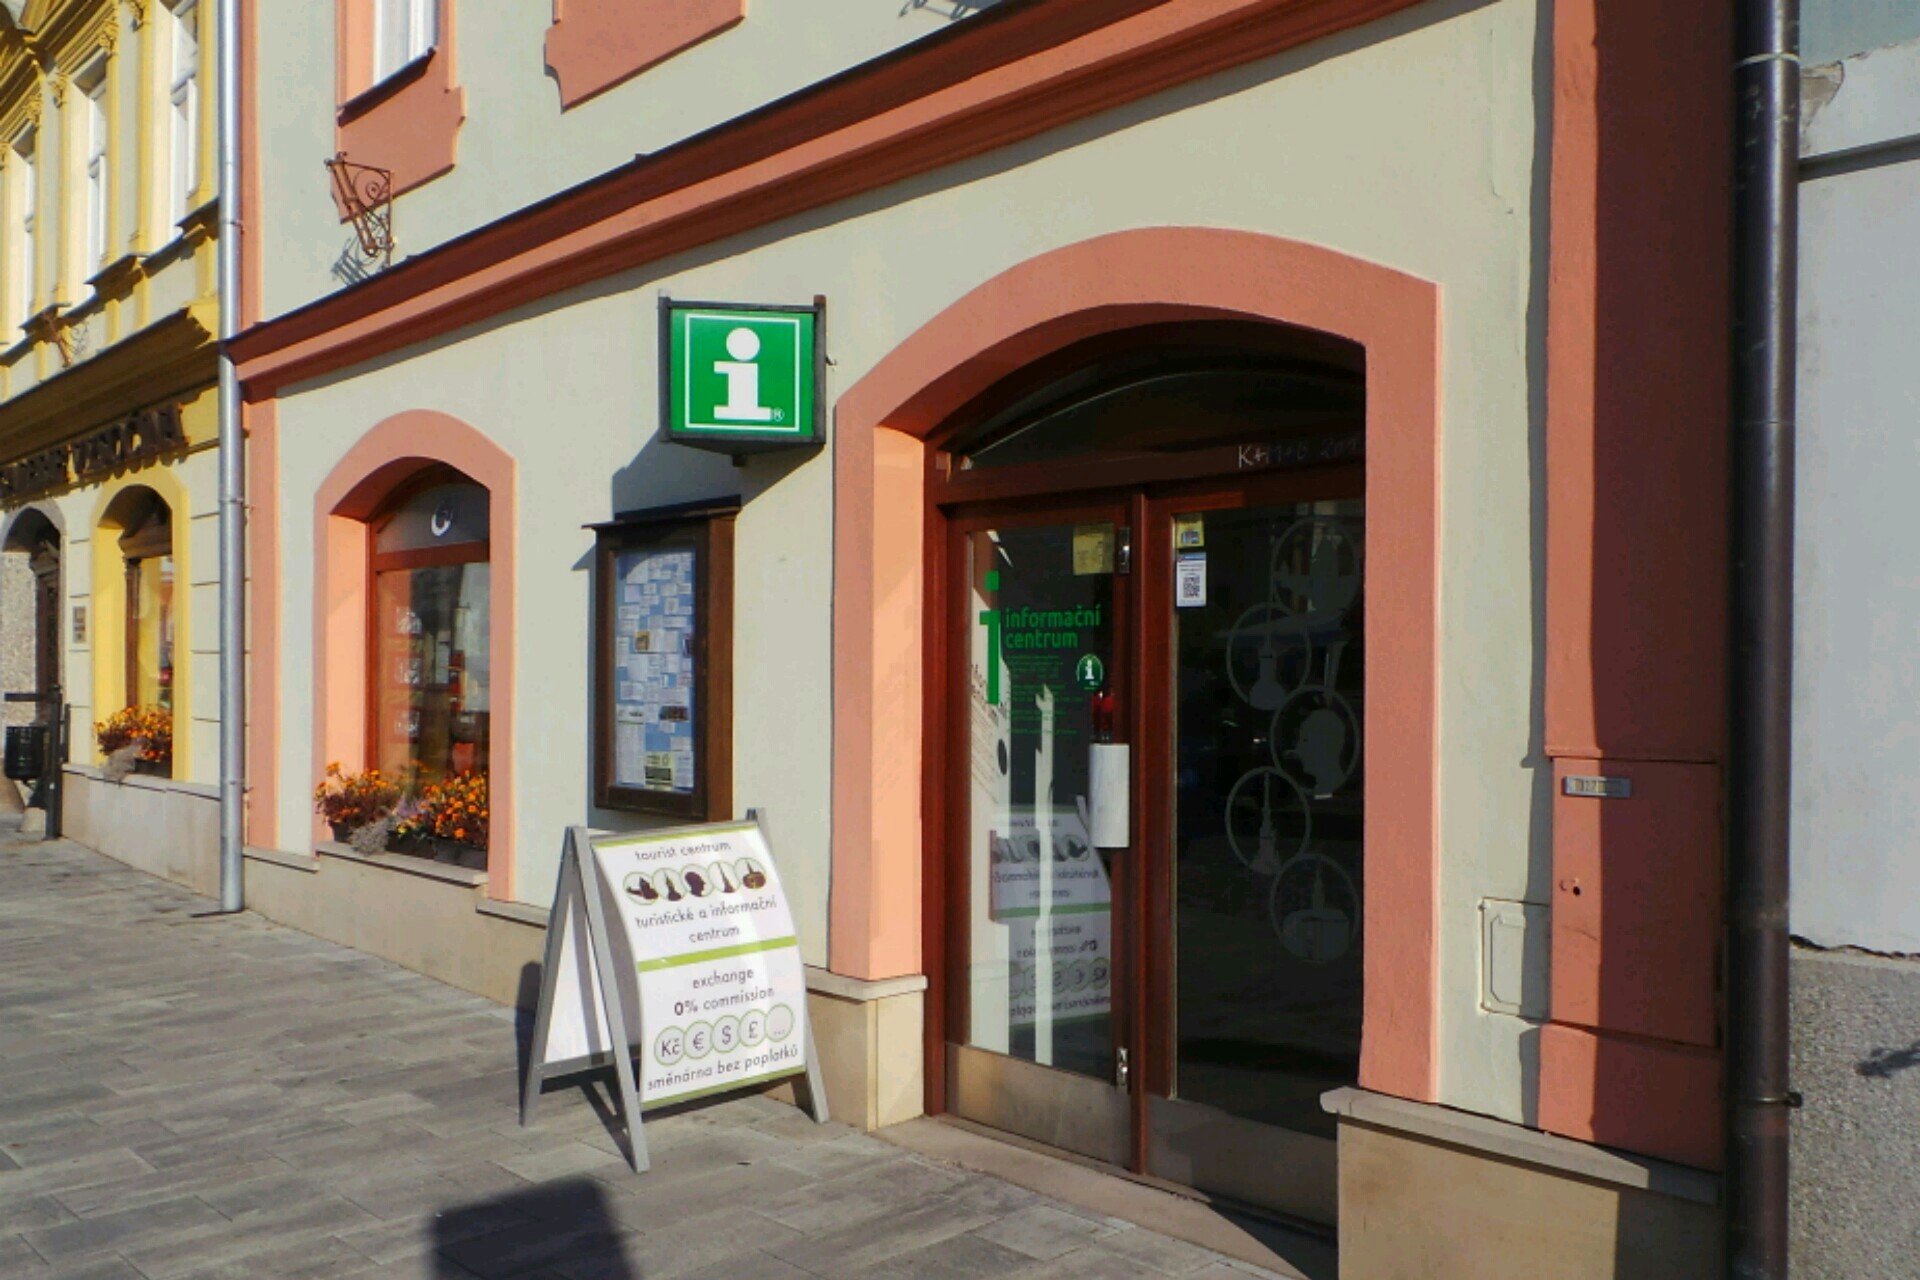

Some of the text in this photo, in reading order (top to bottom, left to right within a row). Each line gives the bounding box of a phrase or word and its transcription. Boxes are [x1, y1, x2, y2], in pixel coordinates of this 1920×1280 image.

[1005, 603, 1102, 628] informační
[1005, 629, 1079, 649] centrum
[635, 842, 731, 861] tourist centrum
[635, 895, 777, 928] turistické a informační
[688, 926, 740, 943] centrum
[692, 969, 754, 989] exchange
[673, 986, 775, 1016] 0% commission
[661, 1037, 680, 1058] Kč
[648, 1045, 799, 1091] směnárna bez poplatků
